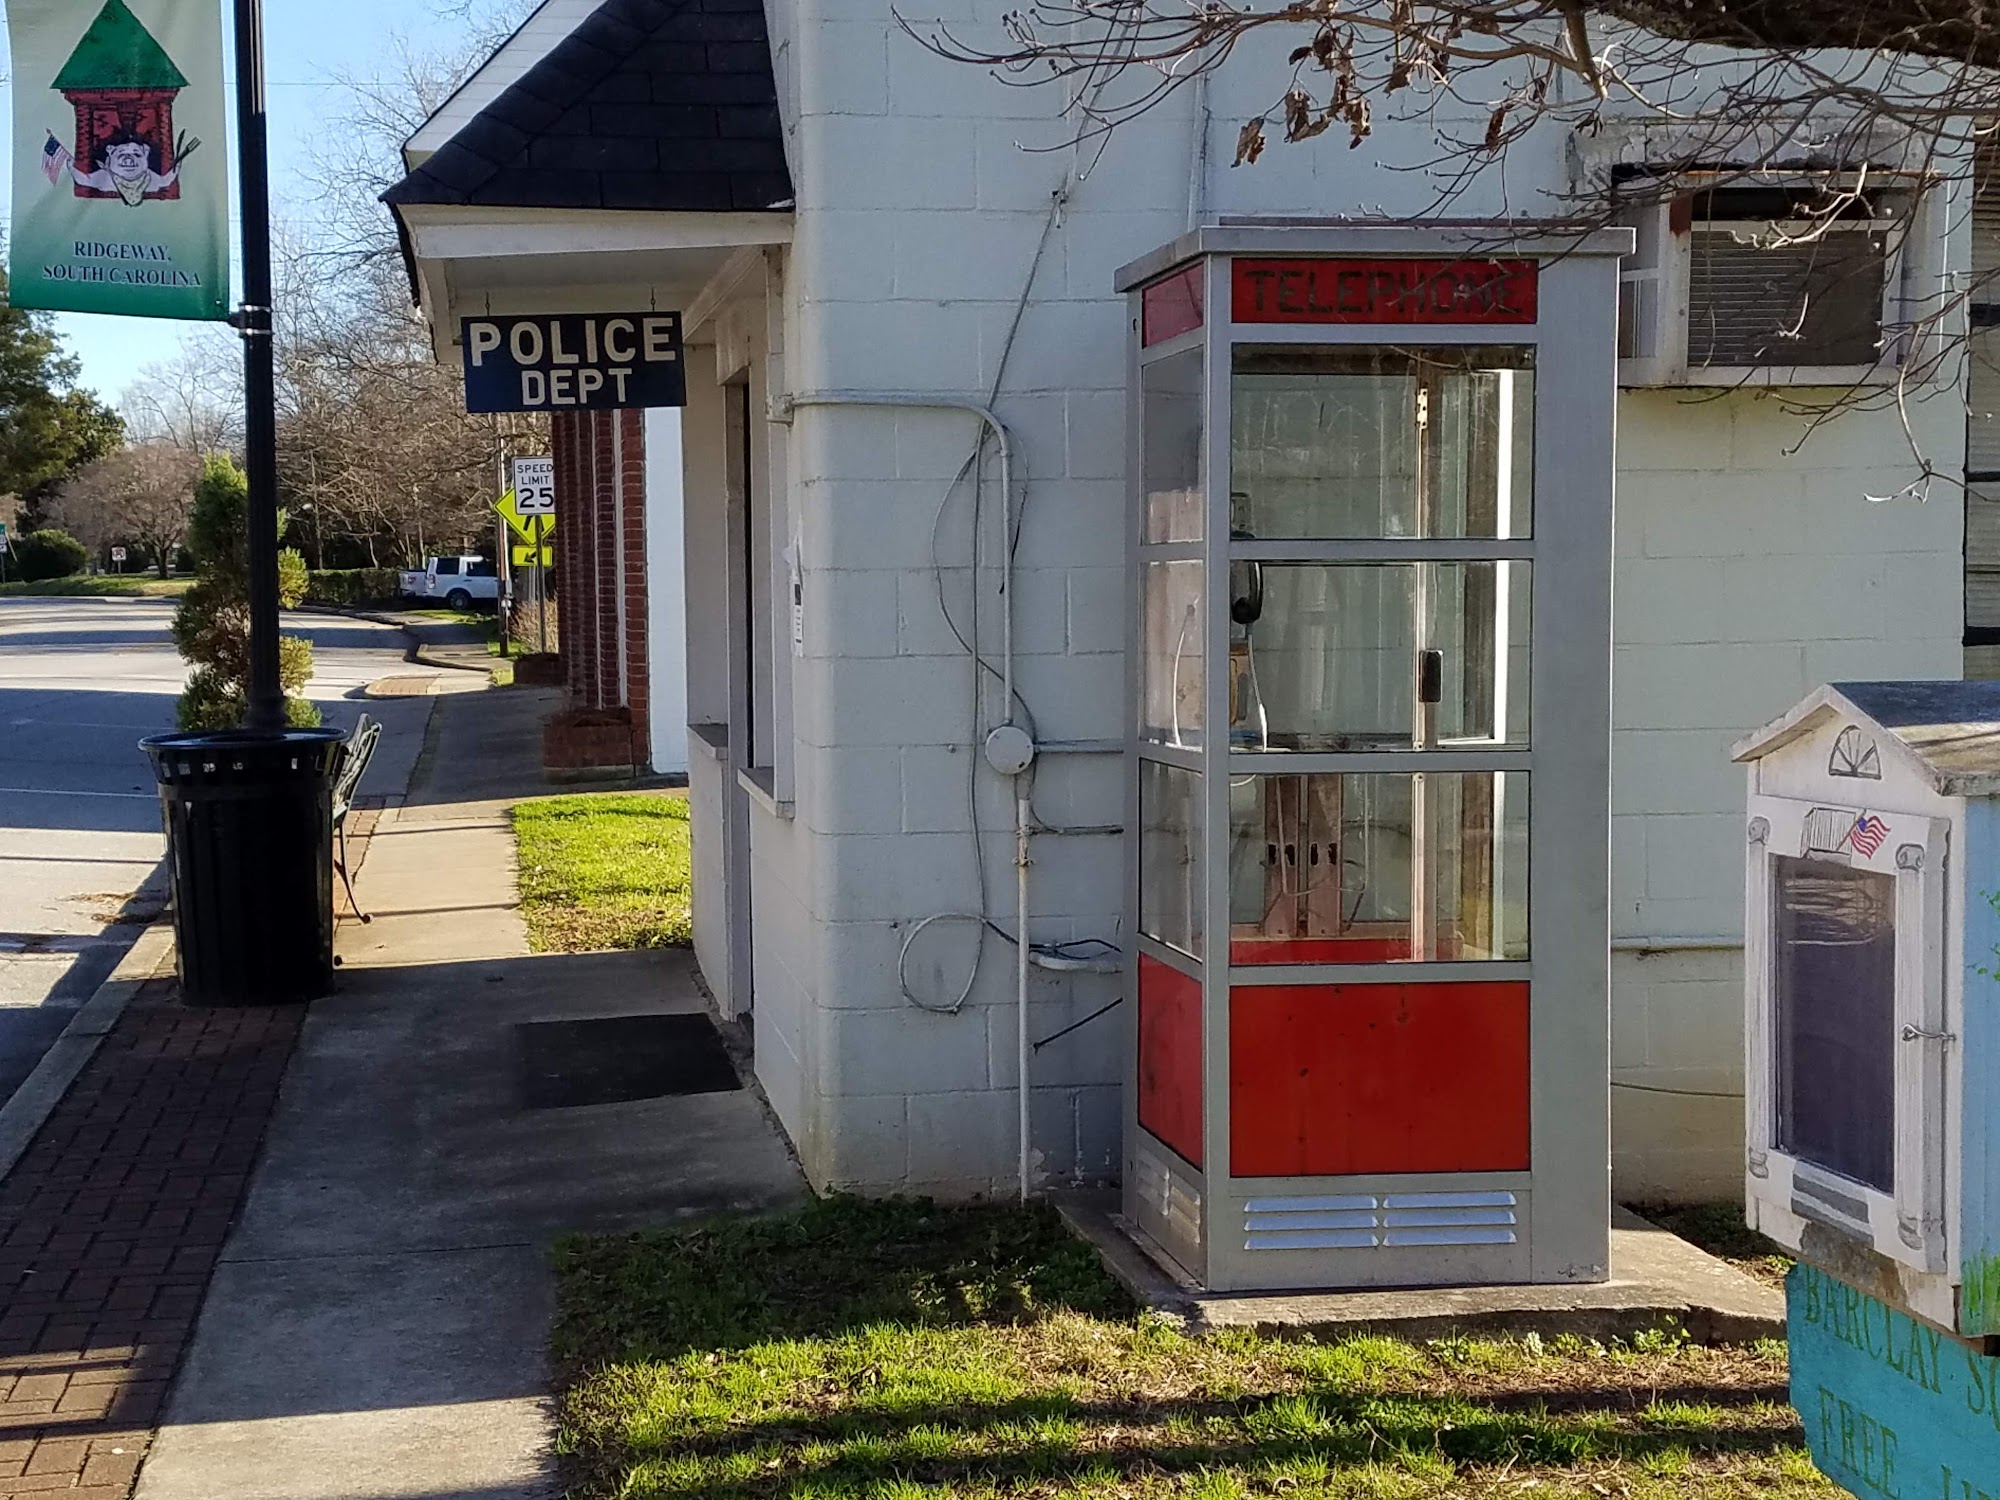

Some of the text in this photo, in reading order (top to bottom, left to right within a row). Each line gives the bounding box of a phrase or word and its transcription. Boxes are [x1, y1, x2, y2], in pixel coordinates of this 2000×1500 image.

[42, 263, 202, 287] SOUTH CAROLINA
[1245, 270, 1525, 314] TELEPHONE
[469, 318, 676, 367] POLICE
[521, 368, 633, 406] DEPT
[517, 463, 554, 474] SPEED
[521, 475, 550, 485] LIMIT
[519, 487, 554, 508] 25
[1806, 1264, 1942, 1395] BARCLAY
[1818, 1384, 1901, 1500] FREE
